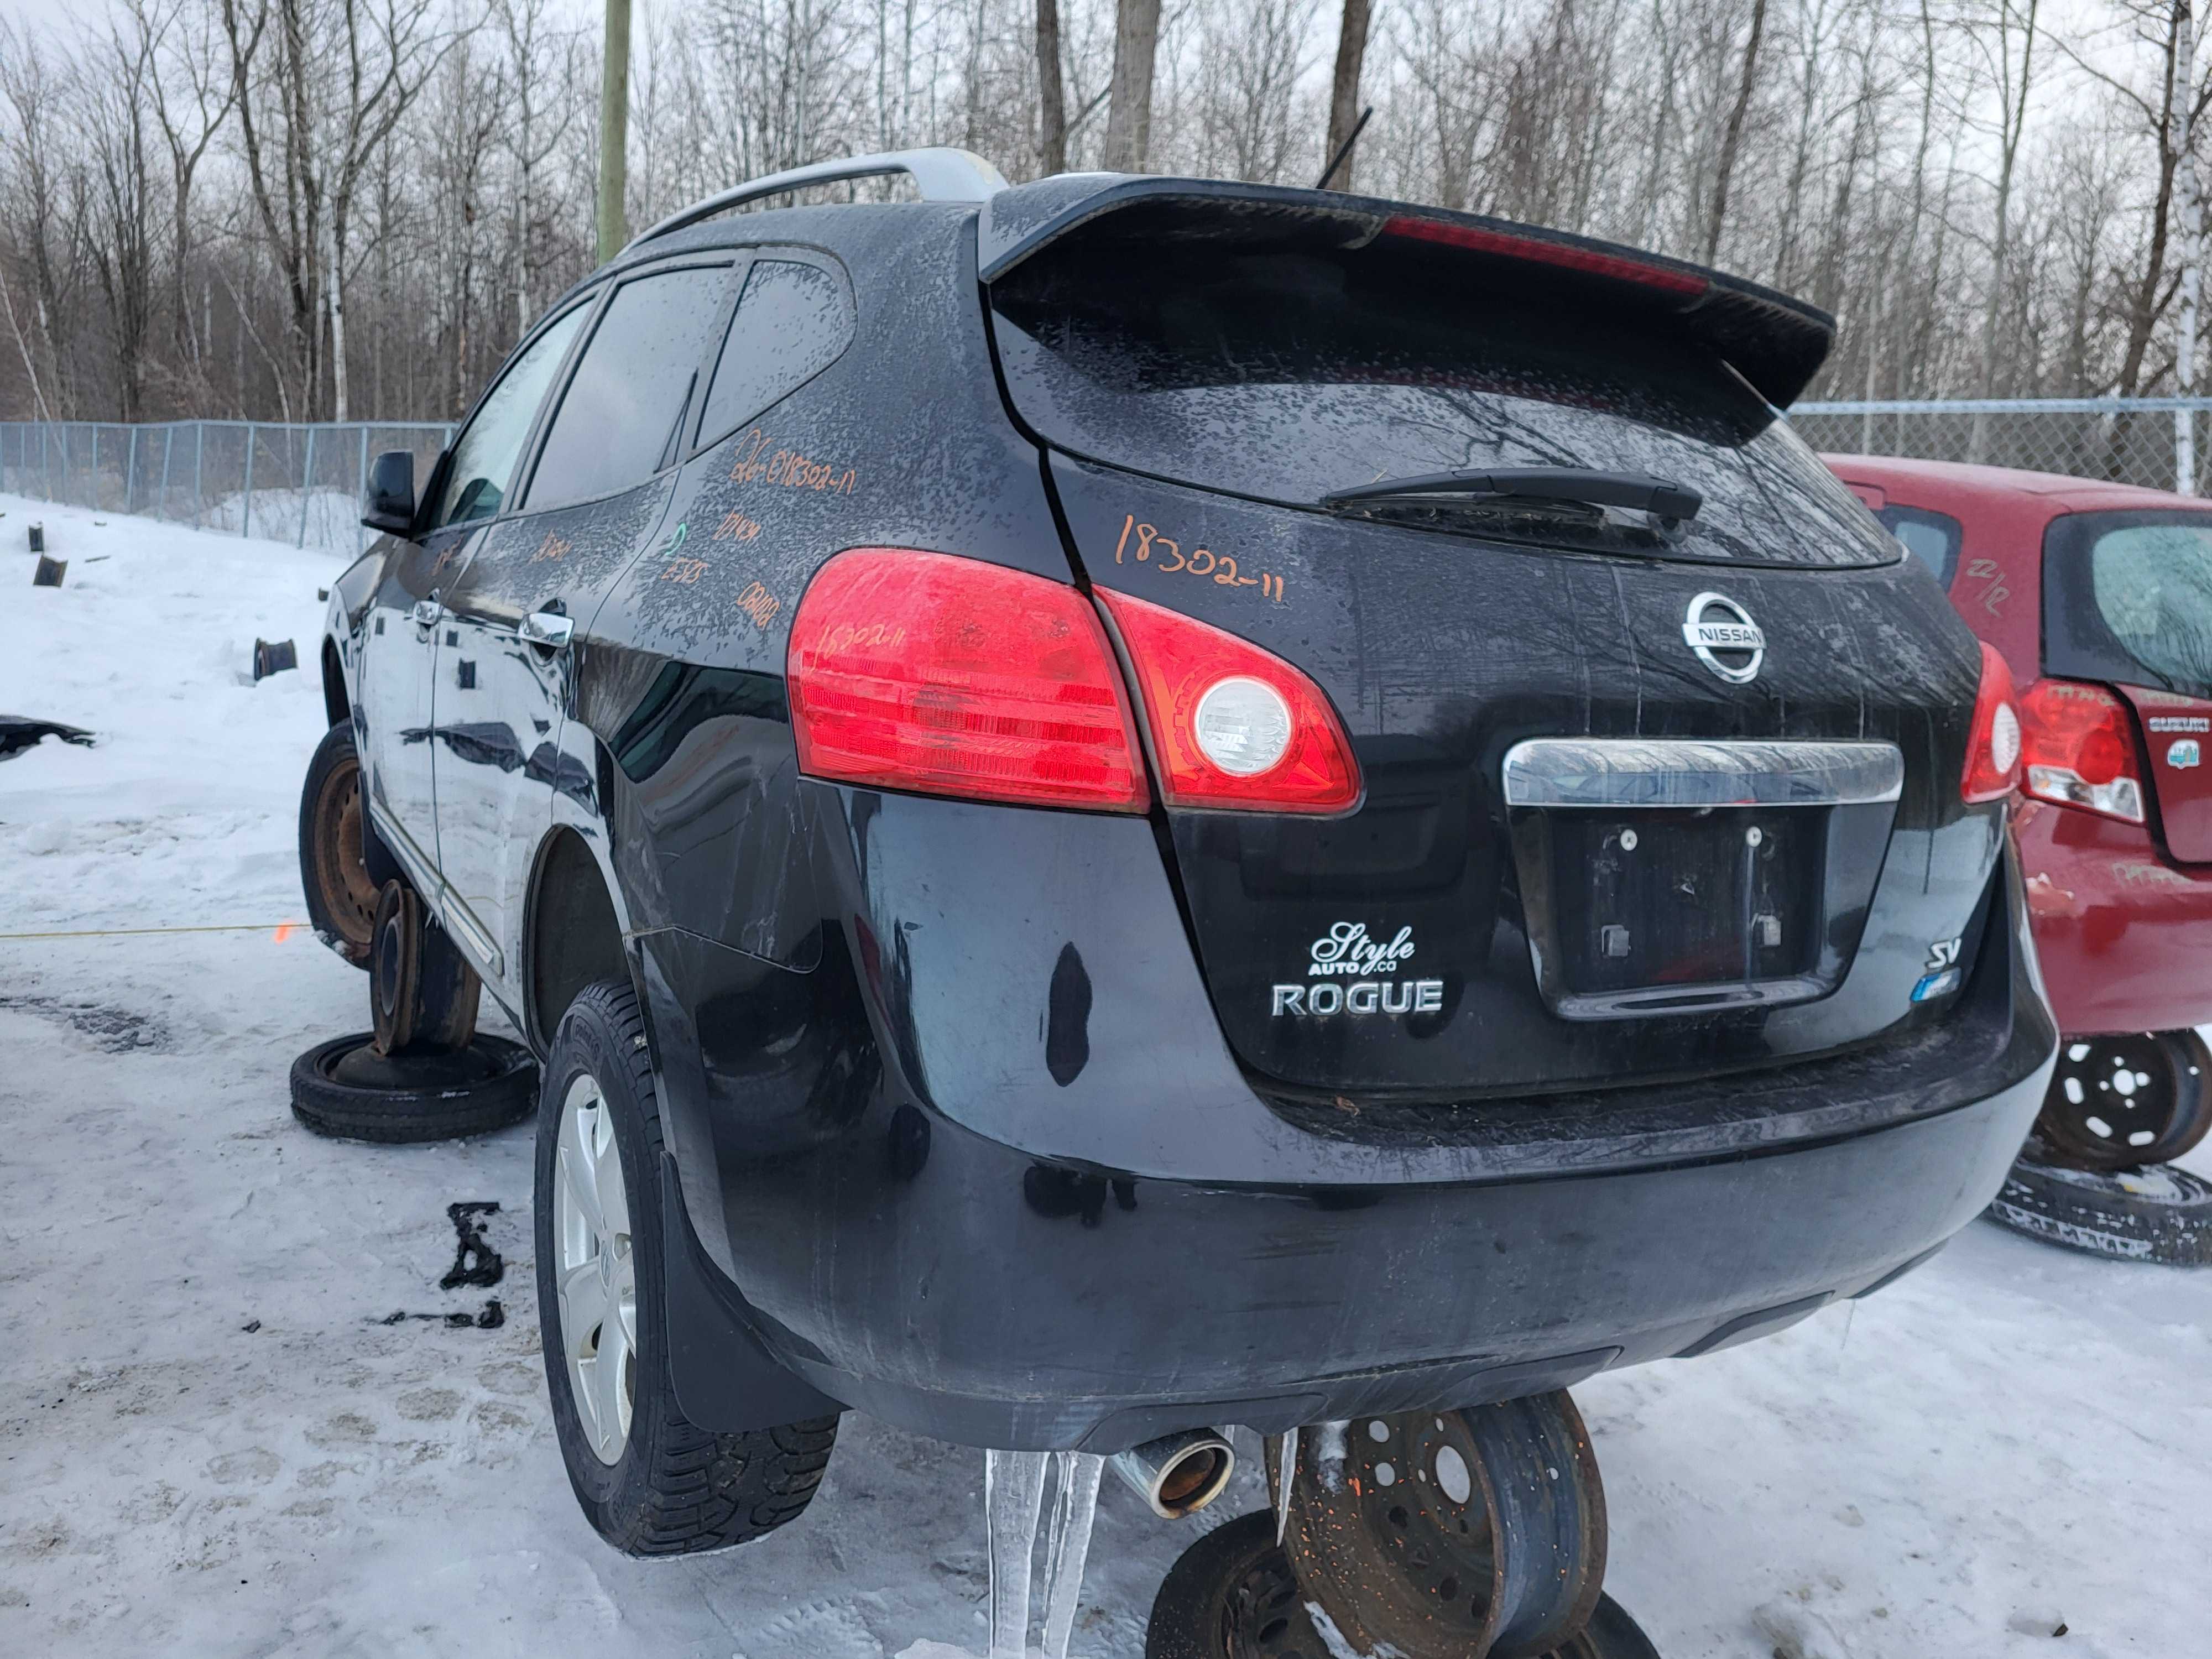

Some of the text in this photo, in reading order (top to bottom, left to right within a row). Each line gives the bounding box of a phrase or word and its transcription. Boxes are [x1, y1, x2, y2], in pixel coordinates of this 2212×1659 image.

[1116, 513, 1284, 602] 18302-11
[1698, 628, 1762, 643] NISSAN
[2149, 717, 2210, 732] SUZUKI
[1311, 921, 1416, 976] Style
[1927, 937, 1962, 969] SV
[1307, 961, 1360, 976] AUTO
[1272, 981, 1444, 1016] ROGUE
